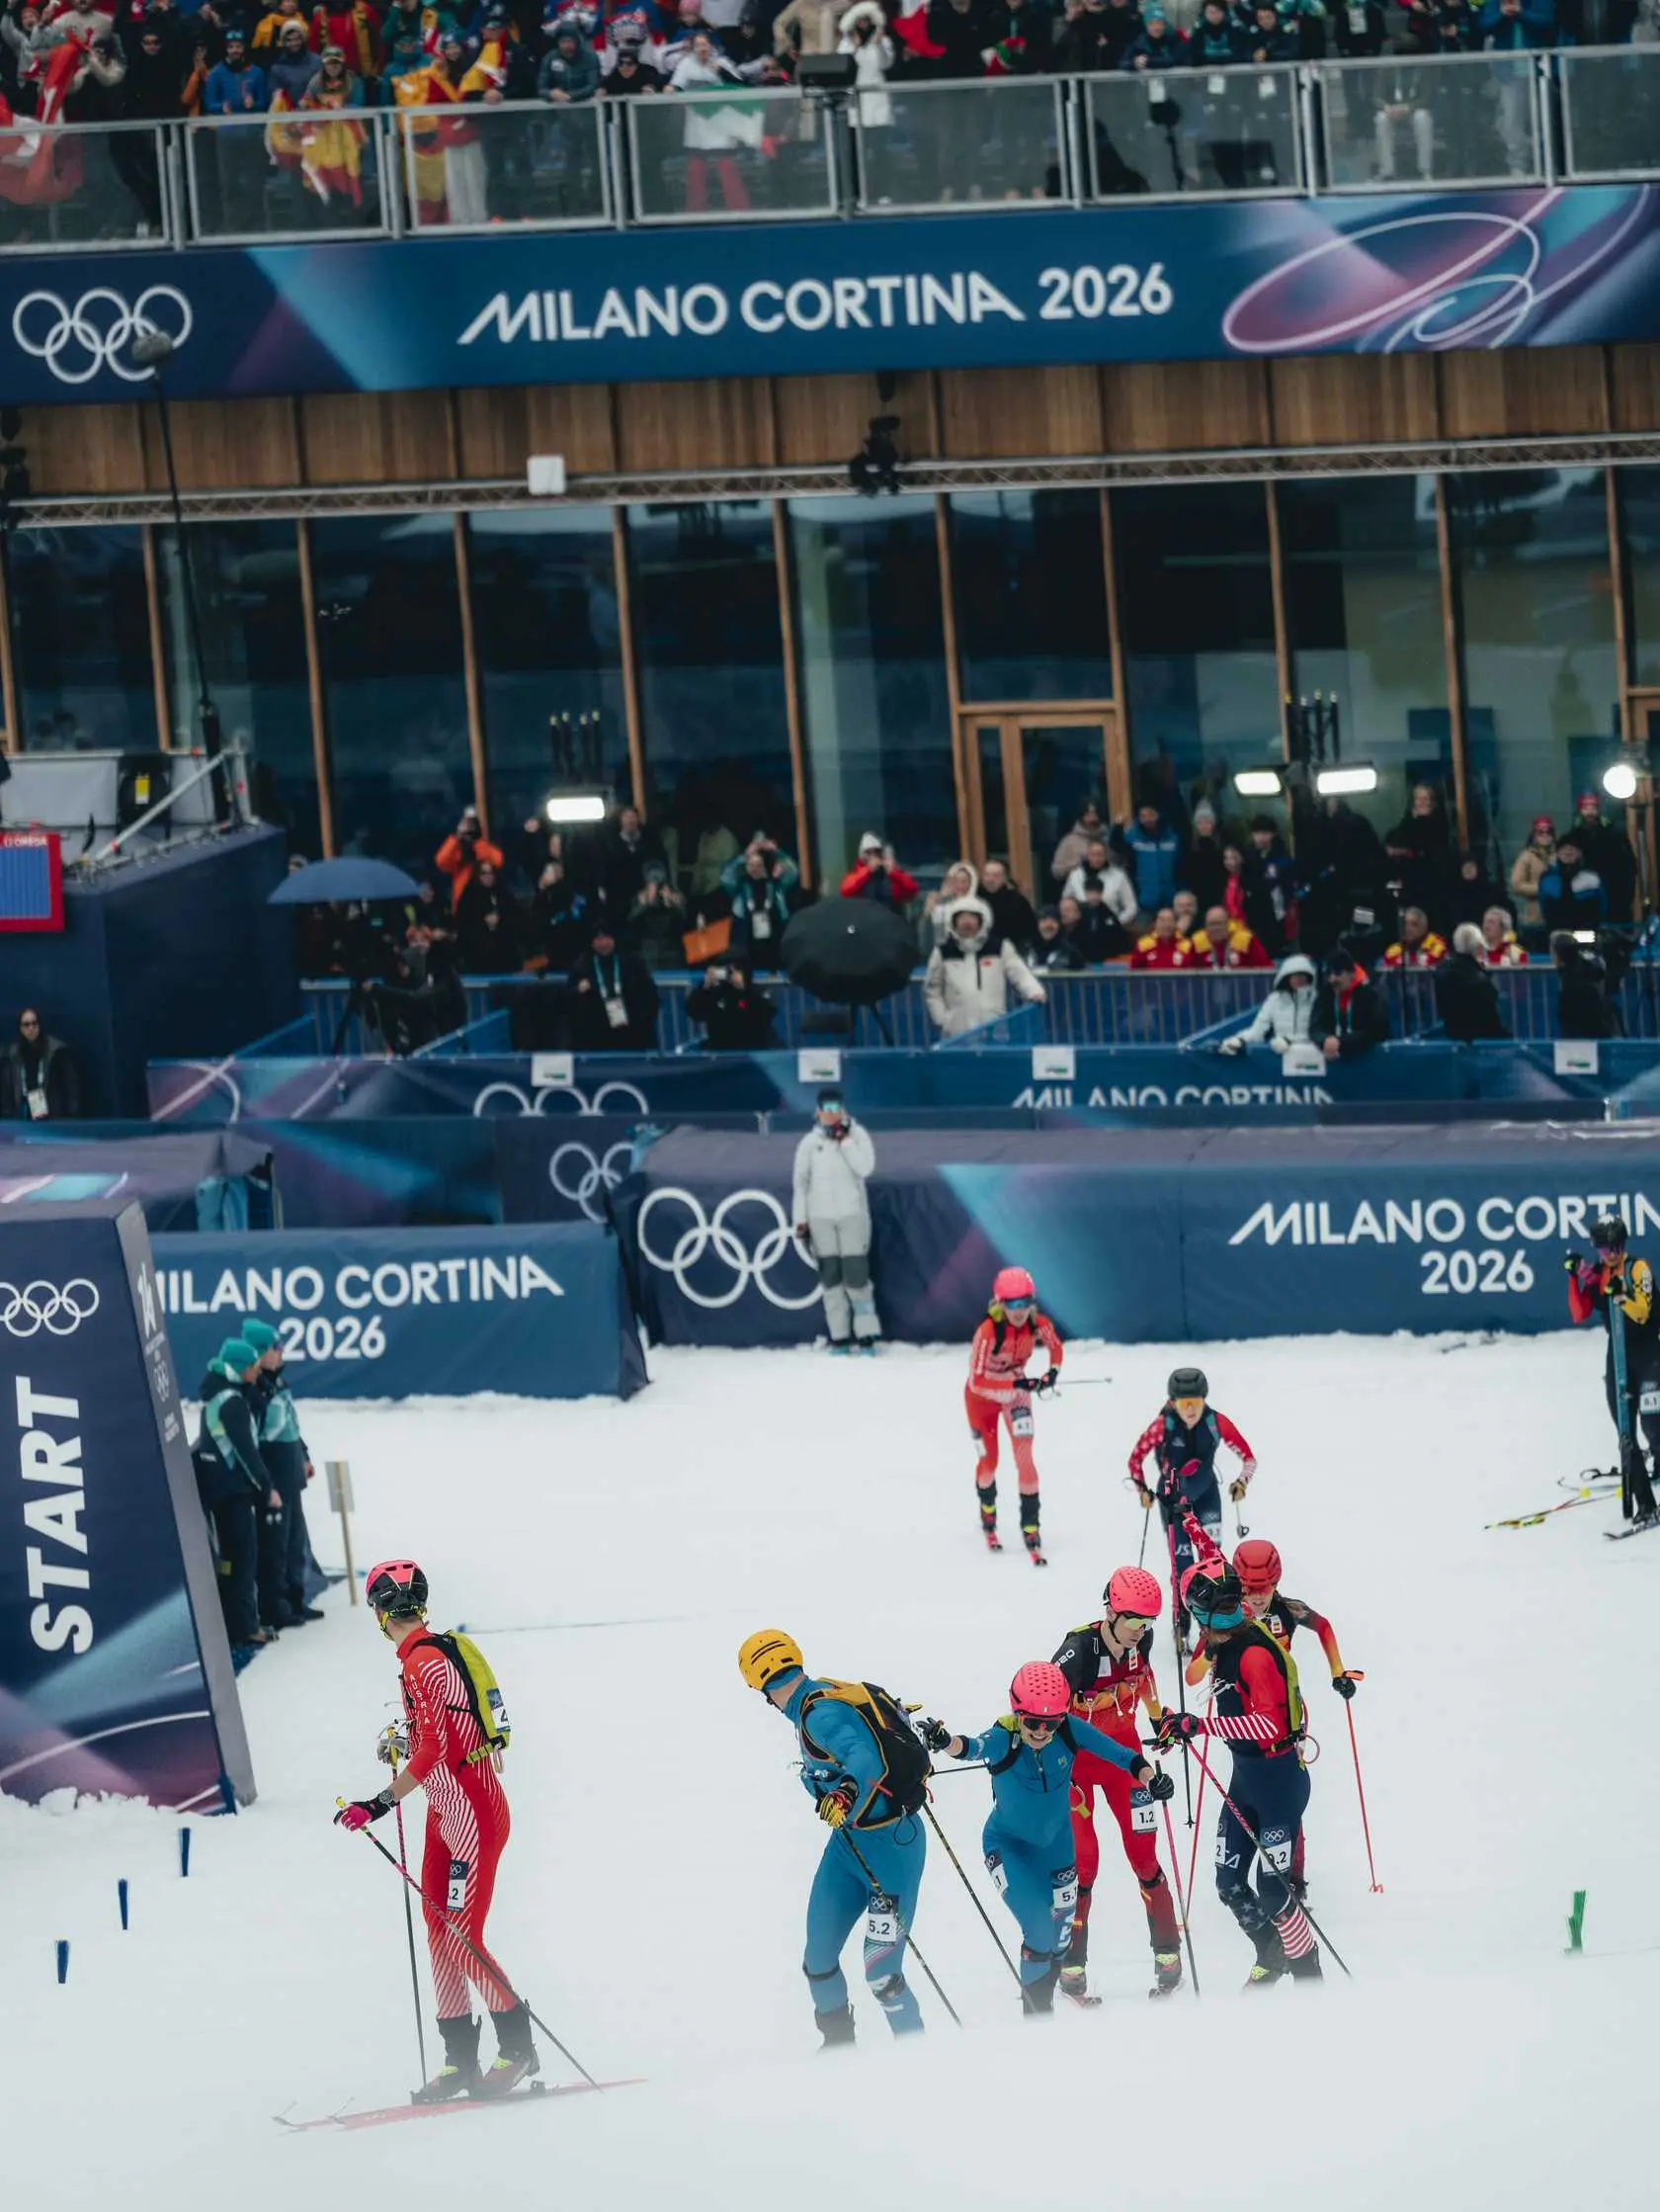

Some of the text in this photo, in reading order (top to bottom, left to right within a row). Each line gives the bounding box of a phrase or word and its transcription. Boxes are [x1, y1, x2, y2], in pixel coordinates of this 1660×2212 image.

[457, 262, 1174, 344] MILANO CORTINA 2026
[1228, 1199, 1465, 1244] MILANO
[335, 1253, 565, 1310] CORTINA
[1421, 1248, 1535, 1294] 2026
[279, 1314, 386, 1362] 2026
[15, 1375, 94, 1655] START
[1139, 1811, 1155, 1825] 1.2
[869, 1919, 891, 1935] 5.2
